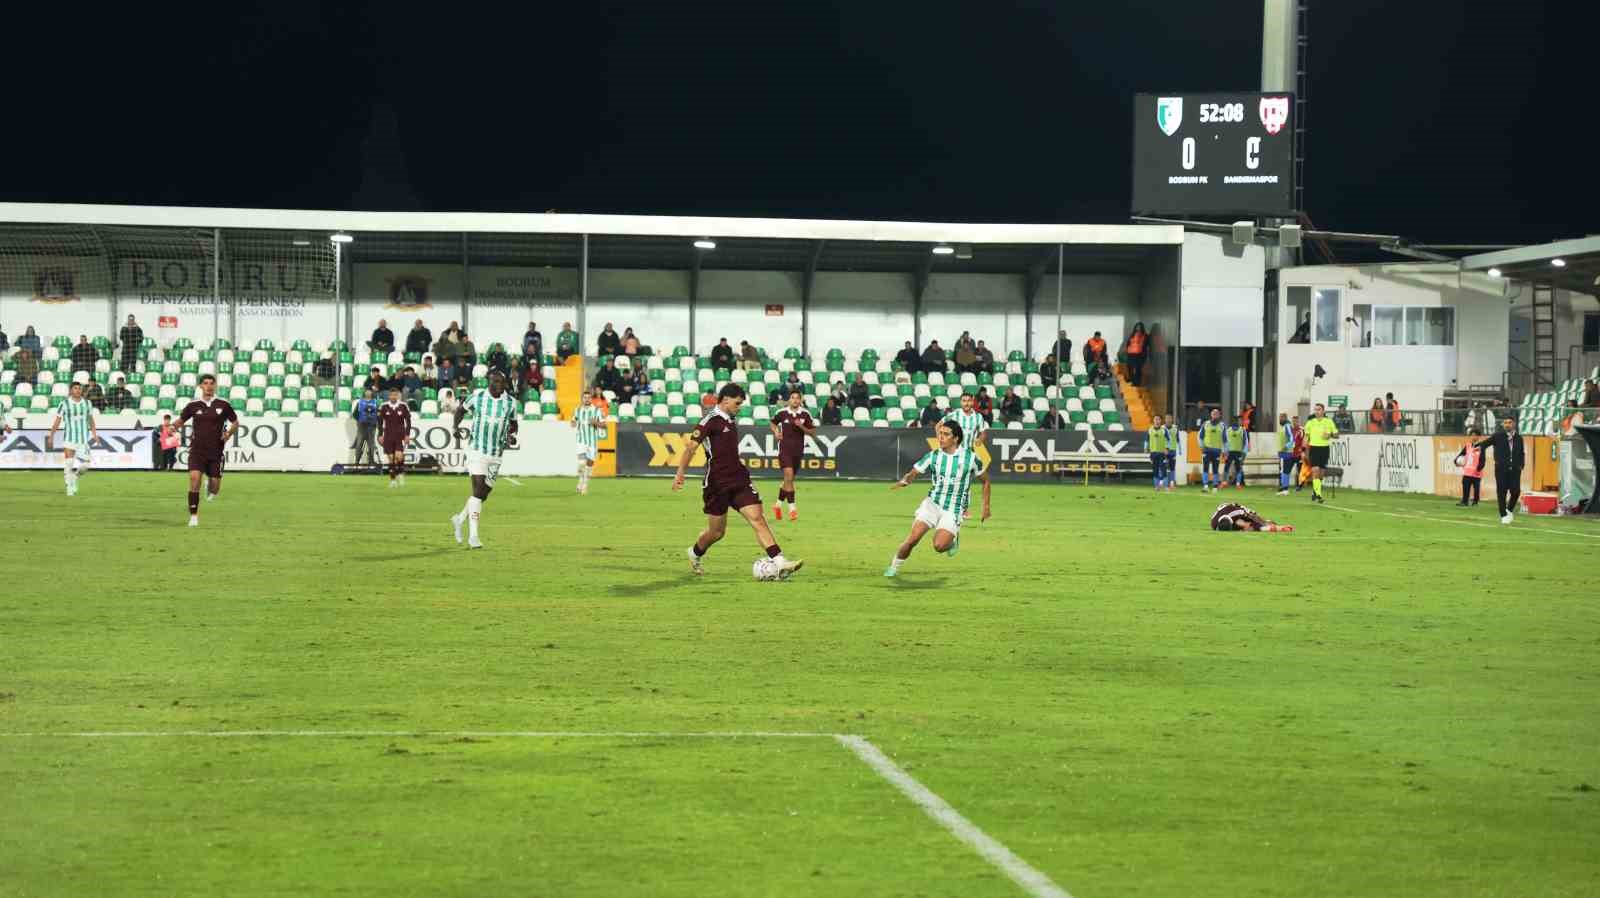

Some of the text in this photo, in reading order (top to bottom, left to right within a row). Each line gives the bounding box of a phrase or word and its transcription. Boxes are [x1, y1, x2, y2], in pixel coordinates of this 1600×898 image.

[1199, 103, 1244, 122] 52:08
[1182, 137, 1196, 170] 0
[2, 436, 147, 453] ALAY
[738, 433, 848, 457] ALAY
[992, 438, 1129, 461] TALAY
[1379, 439, 1420, 470] ACROPOL
